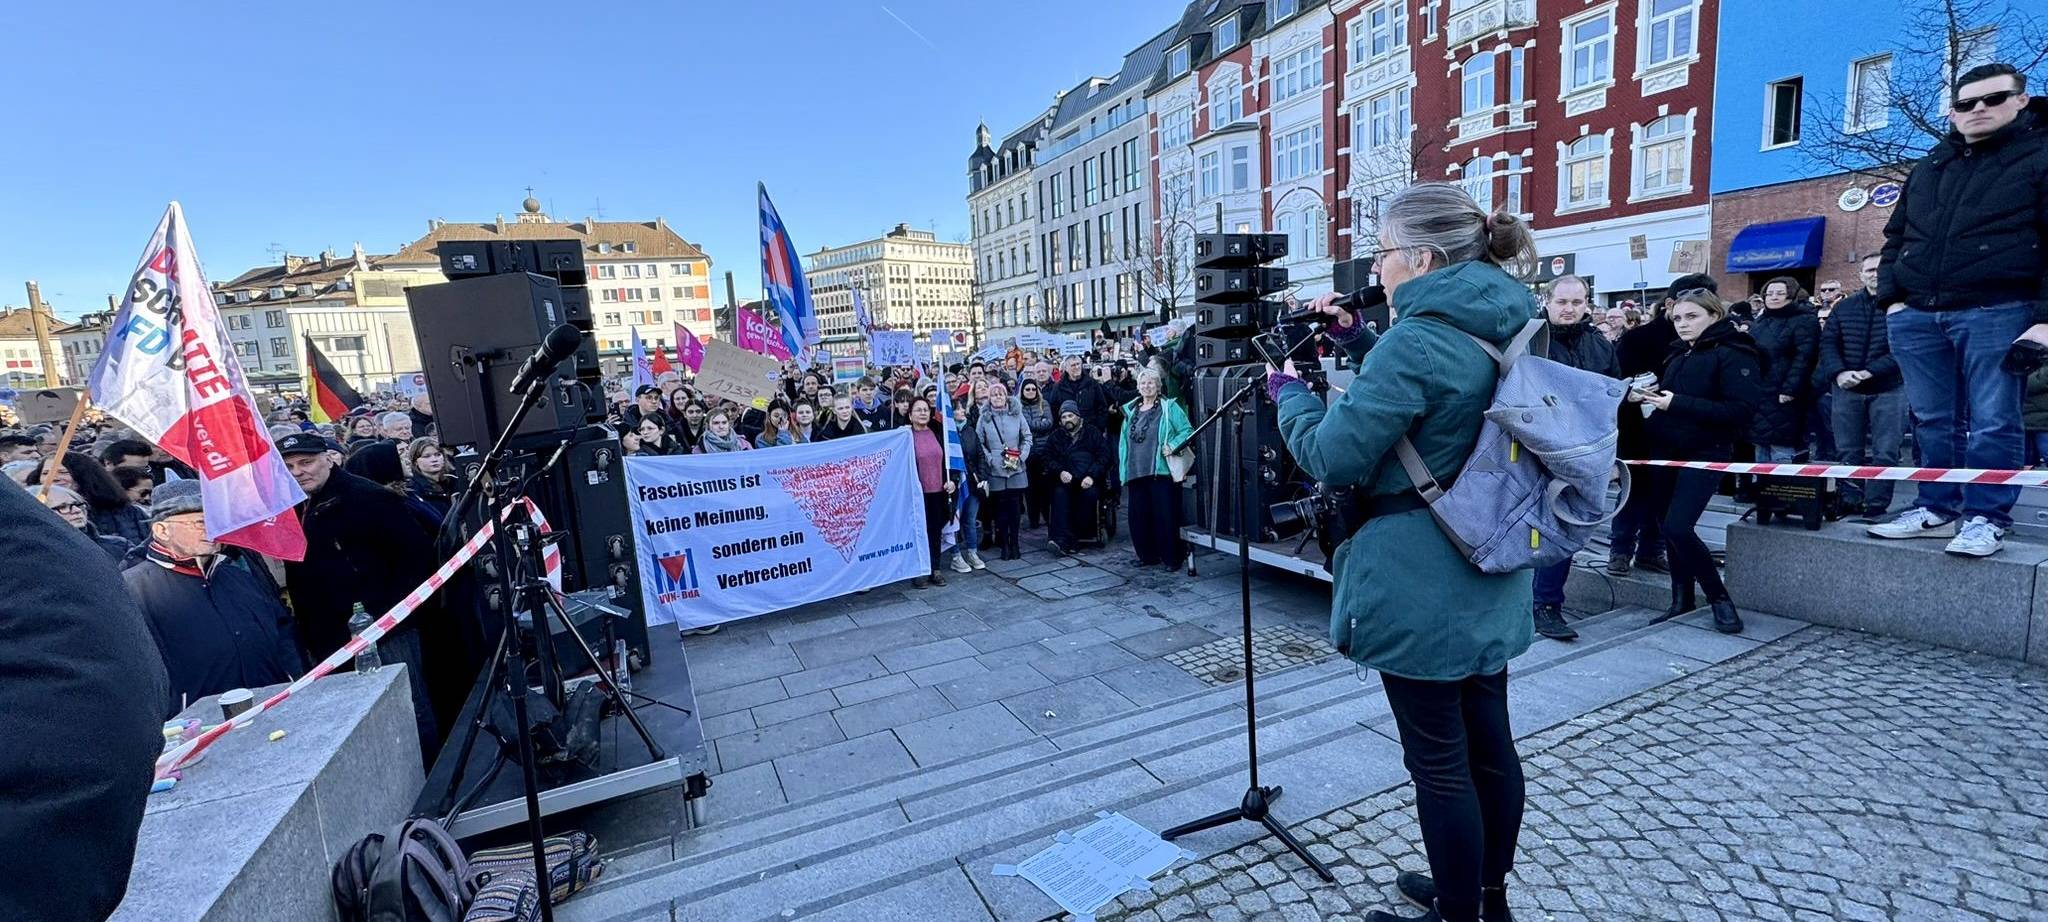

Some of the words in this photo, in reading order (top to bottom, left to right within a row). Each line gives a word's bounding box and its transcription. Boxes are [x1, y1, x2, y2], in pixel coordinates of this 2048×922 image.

[638, 478, 737, 502] Faschismus
[740, 474, 761, 490] ist
[645, 515, 691, 536] keine
[694, 505, 769, 528] Meinung,
[712, 536, 777, 559] sondern
[780, 531, 804, 548] ein
[716, 557, 813, 590] Verbrechen!
